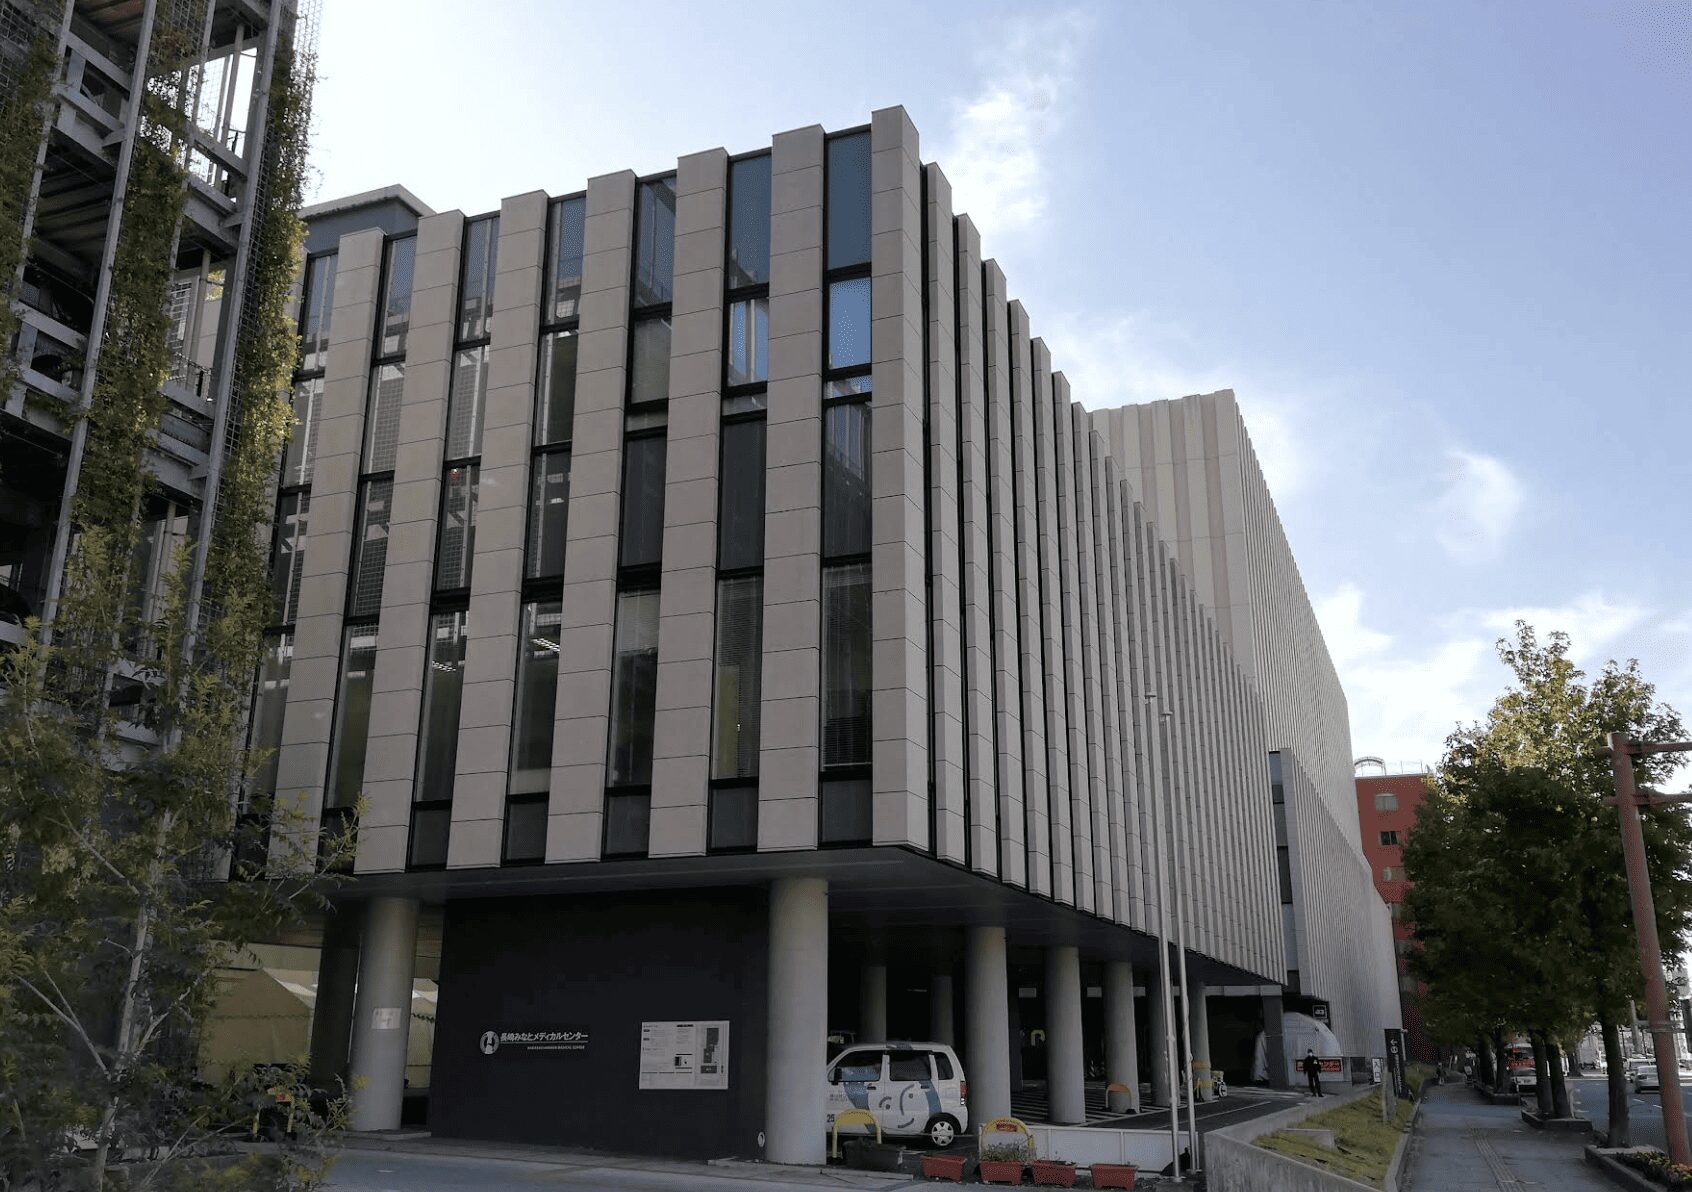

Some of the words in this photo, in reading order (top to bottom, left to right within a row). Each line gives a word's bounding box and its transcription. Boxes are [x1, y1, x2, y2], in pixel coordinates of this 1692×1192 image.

[500, 1031, 588, 1042] 長崎みなとメディカルセンター
